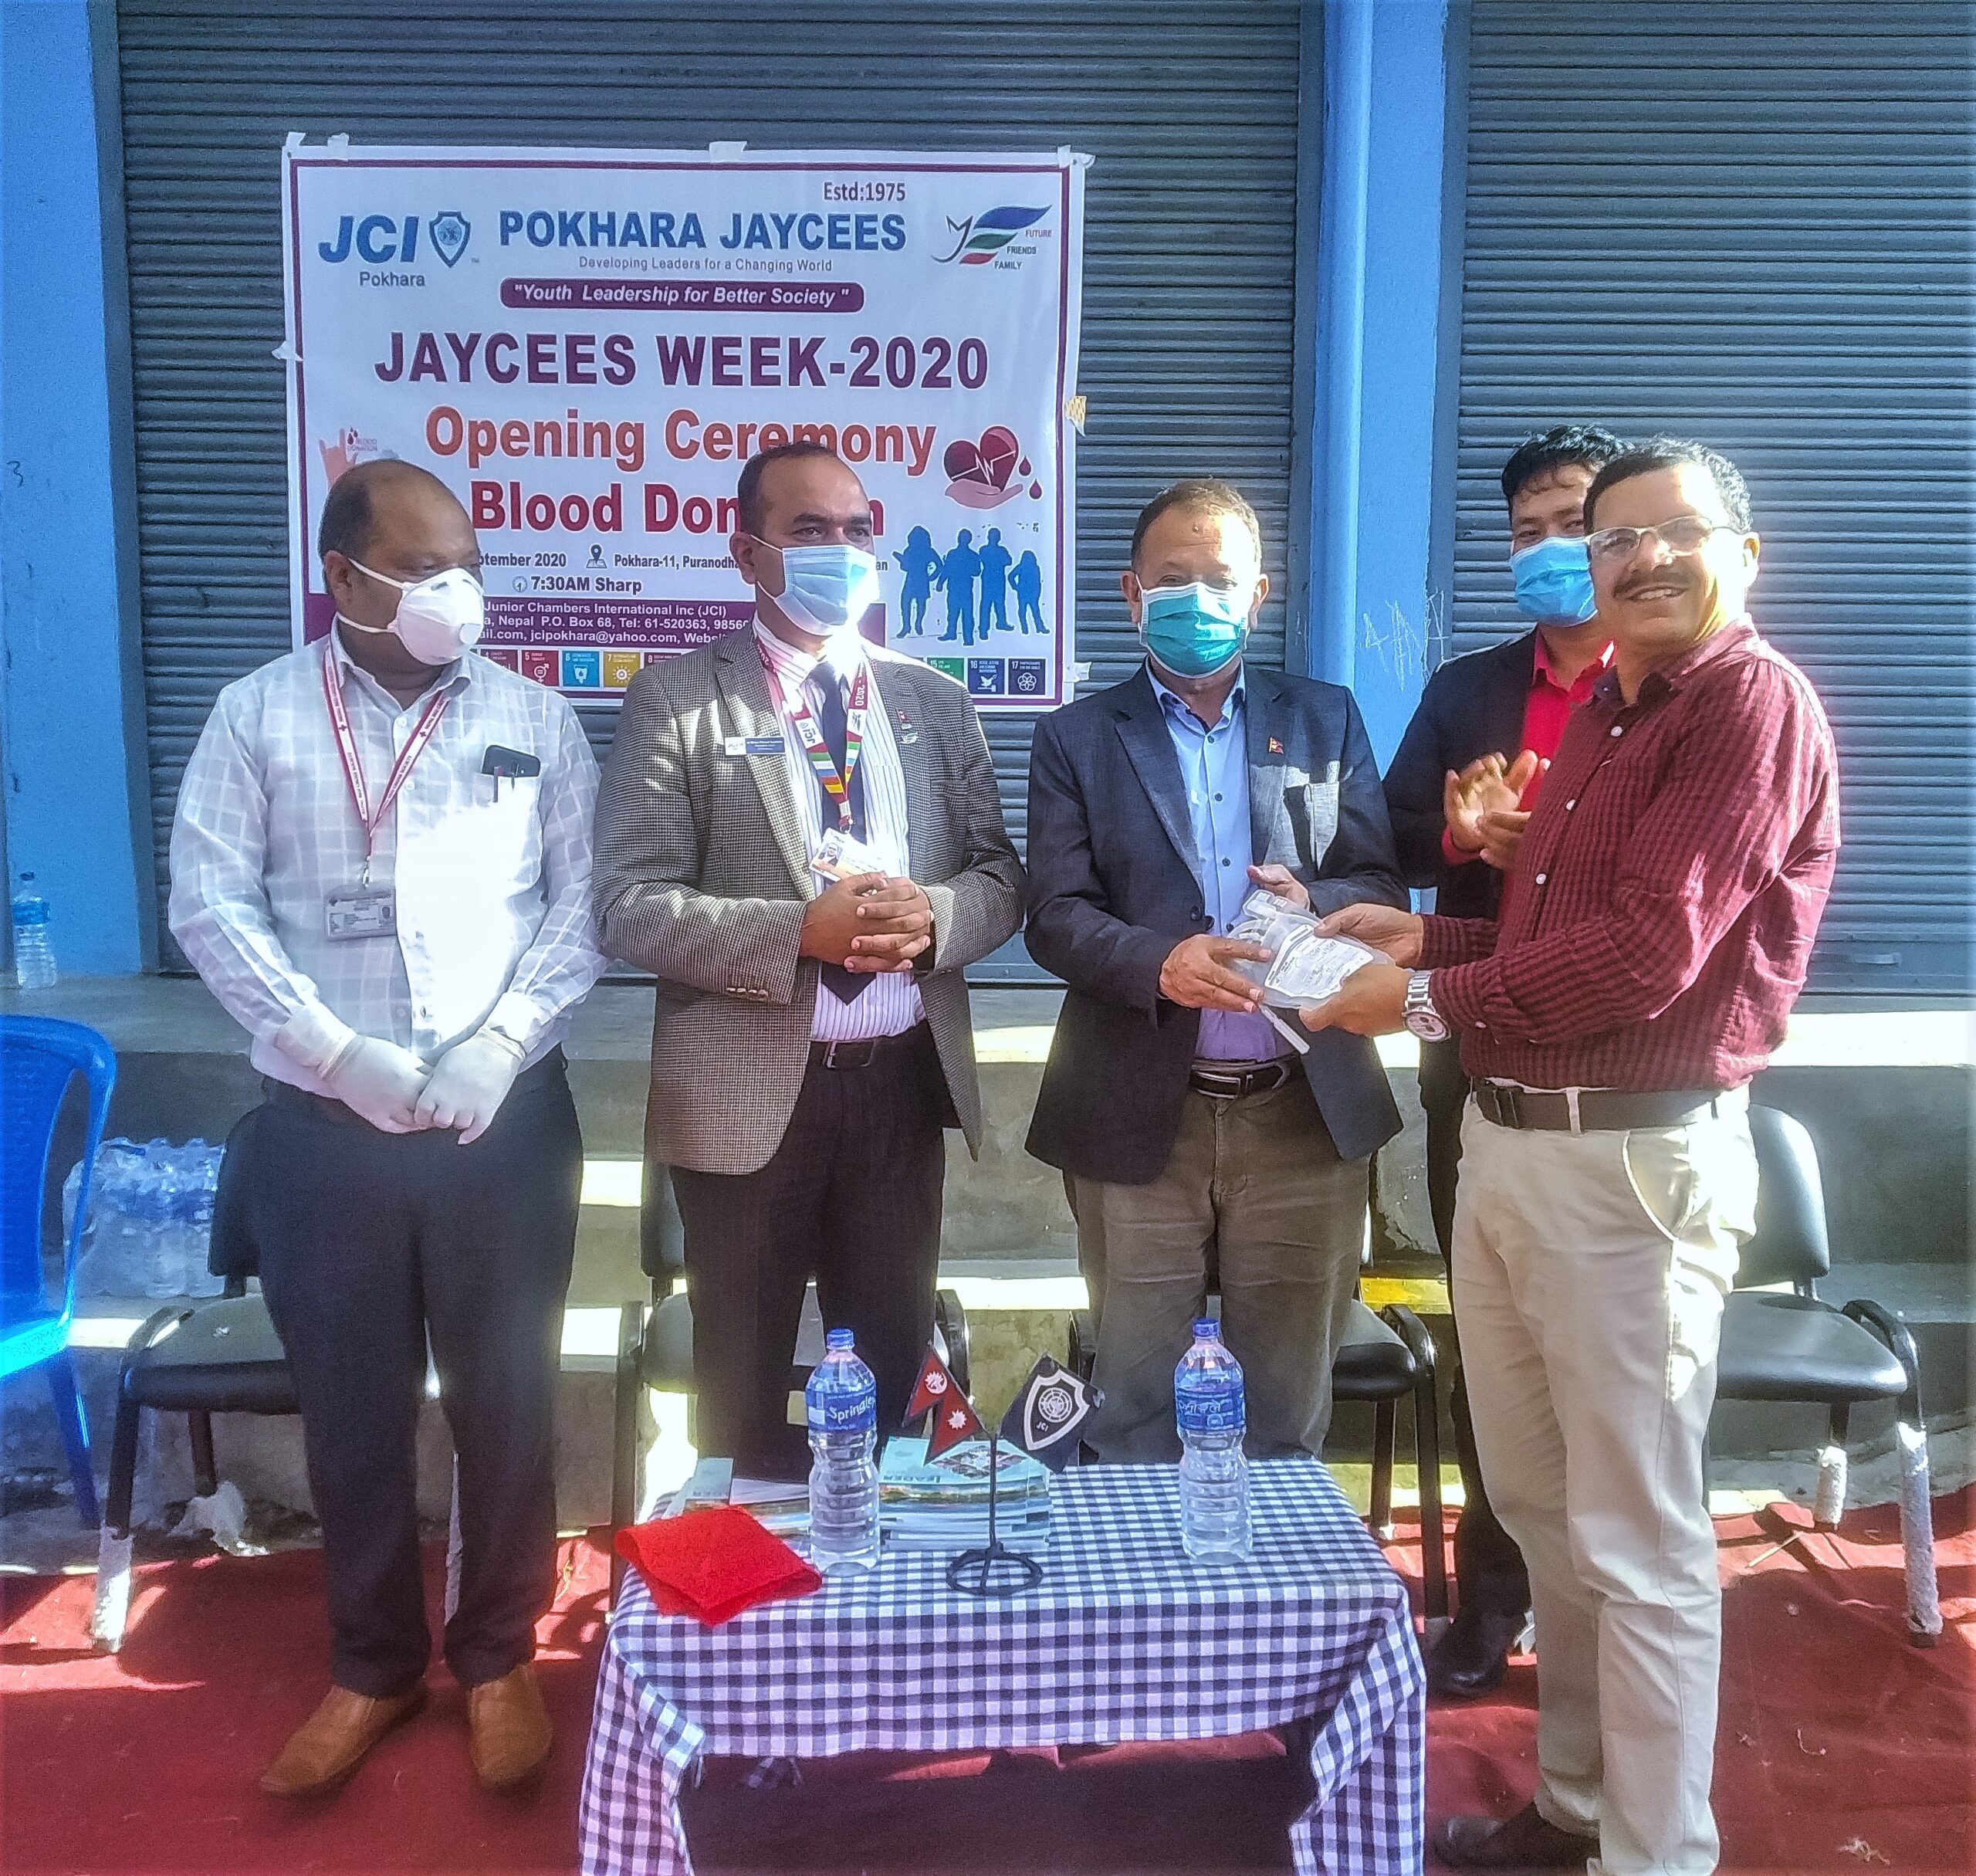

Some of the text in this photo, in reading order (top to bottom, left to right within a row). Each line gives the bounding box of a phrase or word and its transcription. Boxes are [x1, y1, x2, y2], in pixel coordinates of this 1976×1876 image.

[824, 181, 906, 201] Estd:1975
[499, 211, 906, 251] POKHARA JAYCEES
[1025, 229, 1052, 238] FUTURE
[318, 215, 419, 263] JCI
[1007, 246, 1037, 255] FRIENDS
[580, 256, 832, 273] Developing Leaders for a Changing World
[994, 261, 1022, 269] FAMILY
[360, 272, 425, 287] Pokhara
[515, 283, 572, 301] "Youth
[583, 285, 679, 305] Leadership
[684, 286, 709, 303] for
[713, 287, 766, 304] Better
[771, 288, 835, 306] Society
[374, 332, 988, 388] JAYCEES WEEK-2020
[426, 406, 936, 476] Opening Ceremony
[472, 481, 623, 531] Blood
[535, 554, 567, 567] 2020
[614, 554, 679, 570] Pokhara-11,
[531, 576, 642, 595] 7:30AM Sharp
[484, 601, 726, 618] Junior Chambers International Inc (JCI)
[499, 615, 534, 628] Nepal
[542, 616, 564, 627] P.O.
[570, 617, 594, 627] Box
[597, 618, 615, 629] 68,
[619, 618, 641, 628] Tel:
[645, 619, 710, 631] 61-520363,
[479, 629, 527, 641] ail.com,
[530, 629, 680, 643] jcipokhara@yahoo.com,
[525, 652, 530, 661] 5
[648, 655, 652, 663] 8
[930, 660, 937, 669] 15
[970, 660, 977, 669] 16
[1012, 661, 1018, 669] 17
[854, 685, 865, 706] 2020
[804, 729, 816, 743] JCI
[1037, 1421, 1048, 1432] JCI
